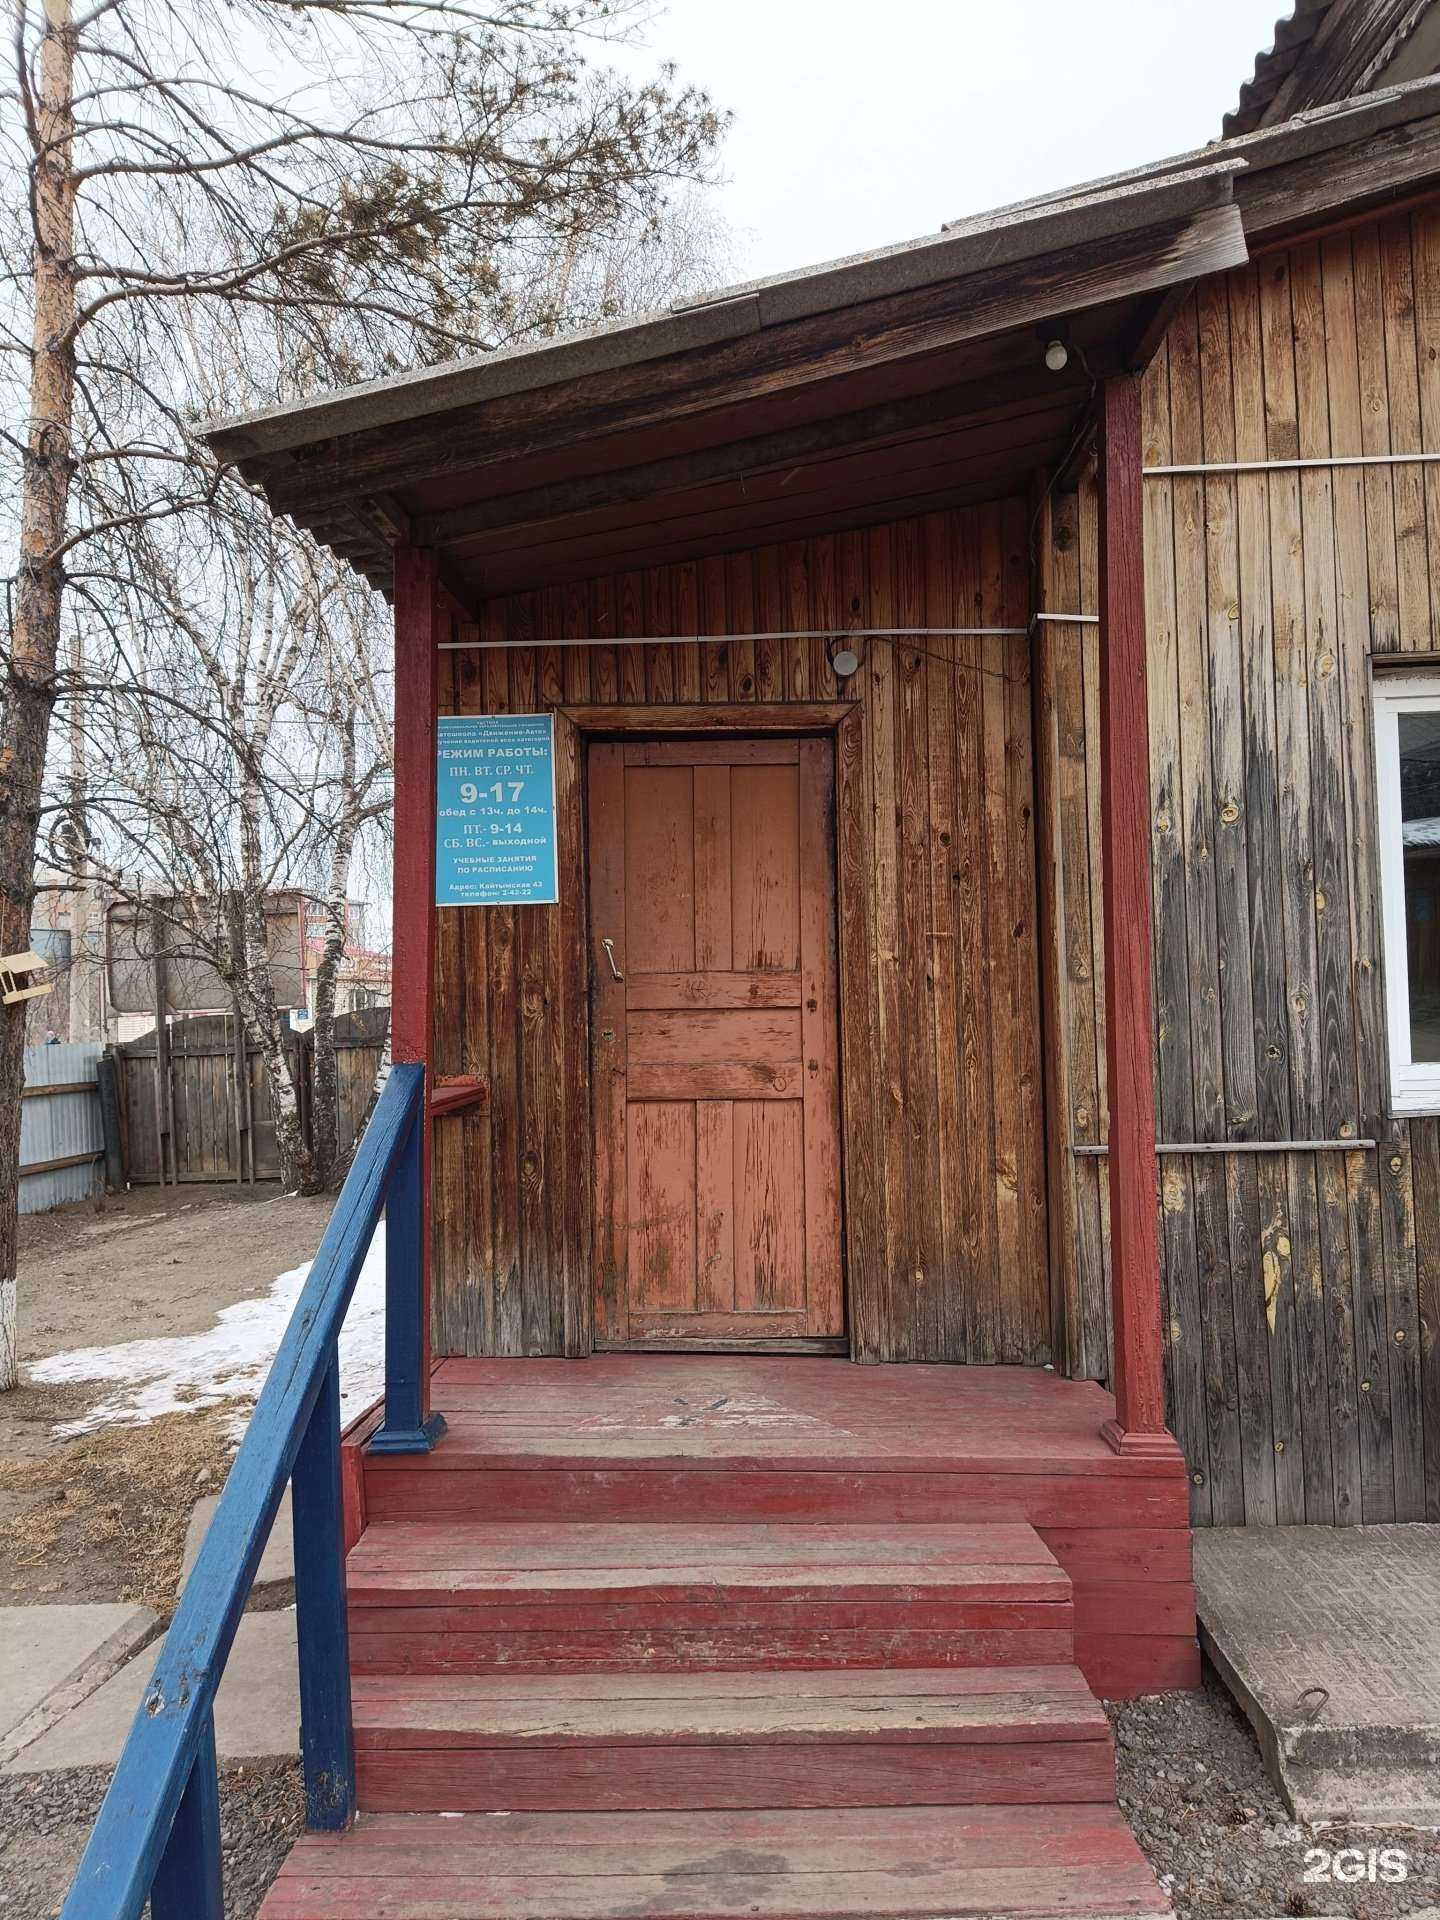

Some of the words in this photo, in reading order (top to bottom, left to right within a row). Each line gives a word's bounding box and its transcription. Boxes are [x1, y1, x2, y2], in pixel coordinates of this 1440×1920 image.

[488, 747, 548, 758] РАБОТЫ:
[450, 767, 471, 777] ПН.
[474, 766, 493, 776] ВТ.
[495, 765, 512, 775] СР.
[515, 764, 534, 775] ЧТ.
[460, 782, 525, 803] 9-17
[439, 808, 466, 817] обед
[480, 807, 504, 815] 13ч.
[524, 806, 547, 814] 14ч.
[490, 823, 523, 834] 9-14
[443, 838, 463, 848] СБ.
[492, 836, 547, 846] выходной
[472, 865, 533, 873] РАСПИСАНИЮ
